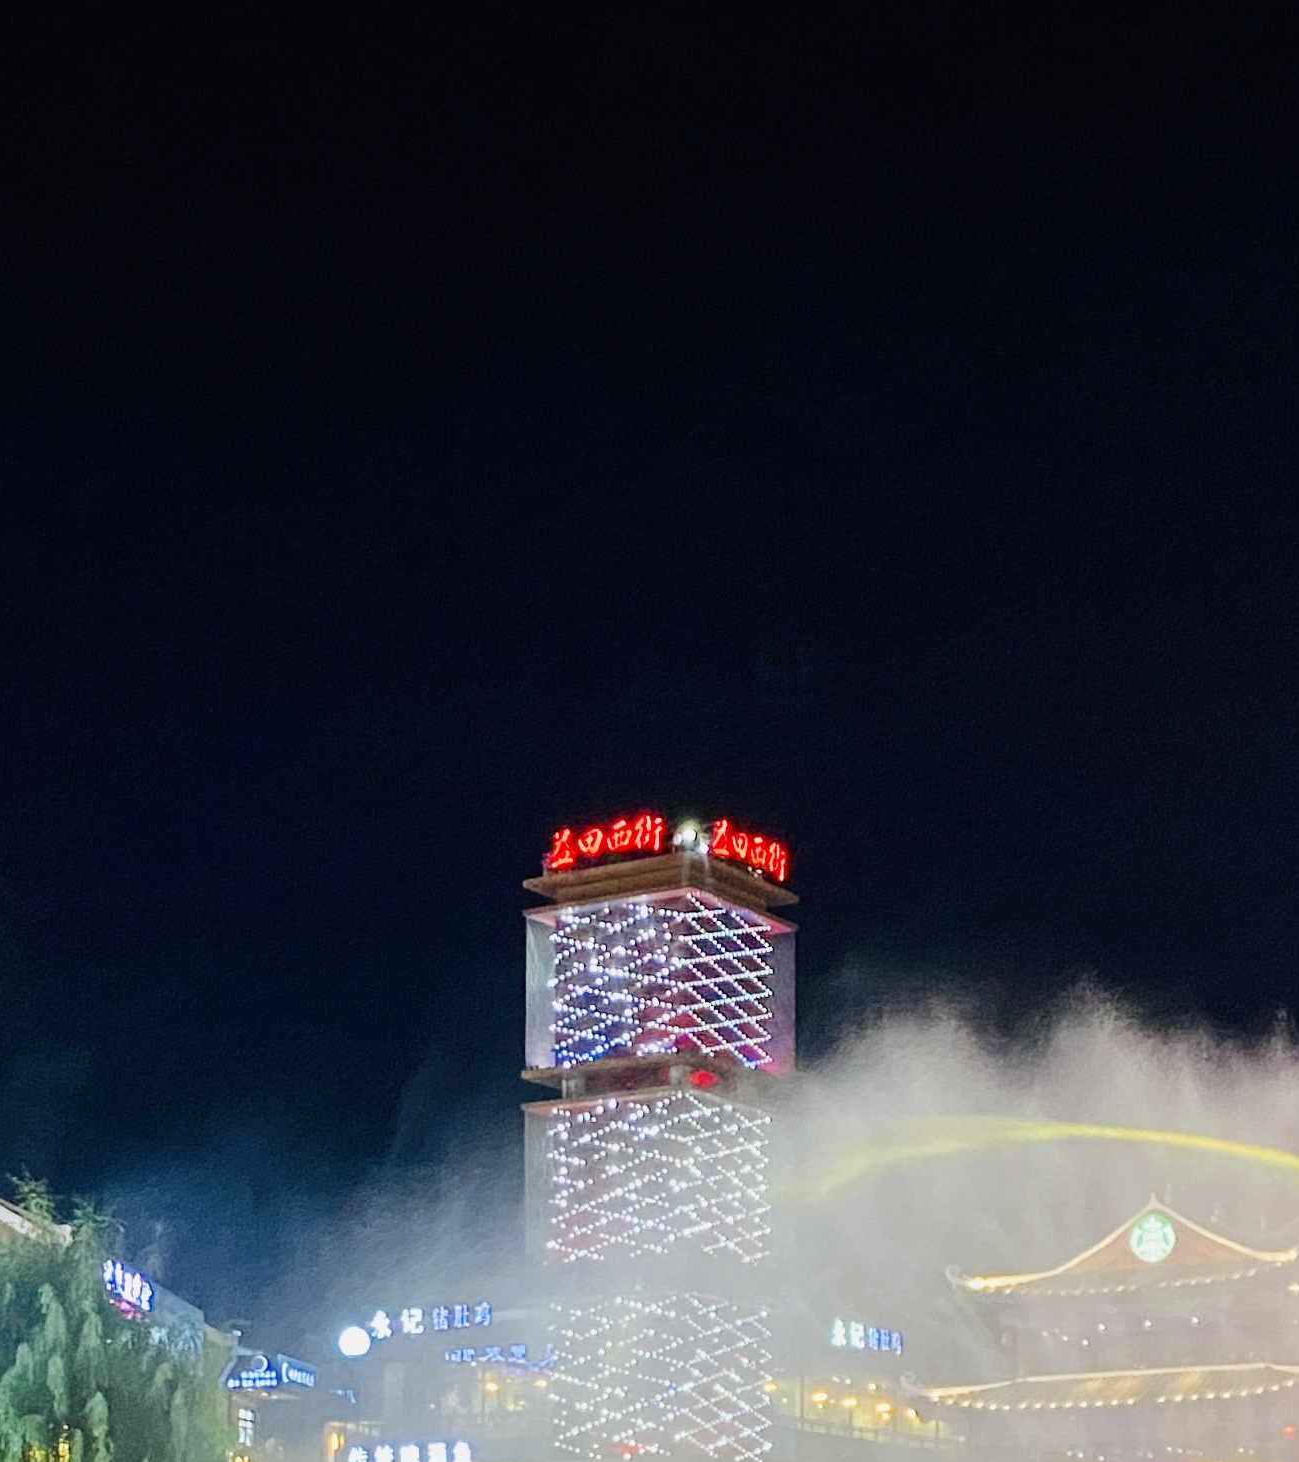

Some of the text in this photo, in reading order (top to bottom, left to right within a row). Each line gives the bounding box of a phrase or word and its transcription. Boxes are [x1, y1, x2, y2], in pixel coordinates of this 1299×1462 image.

[551, 815, 664, 868] 益田西街
[712, 819, 786, 882] 益田西街
